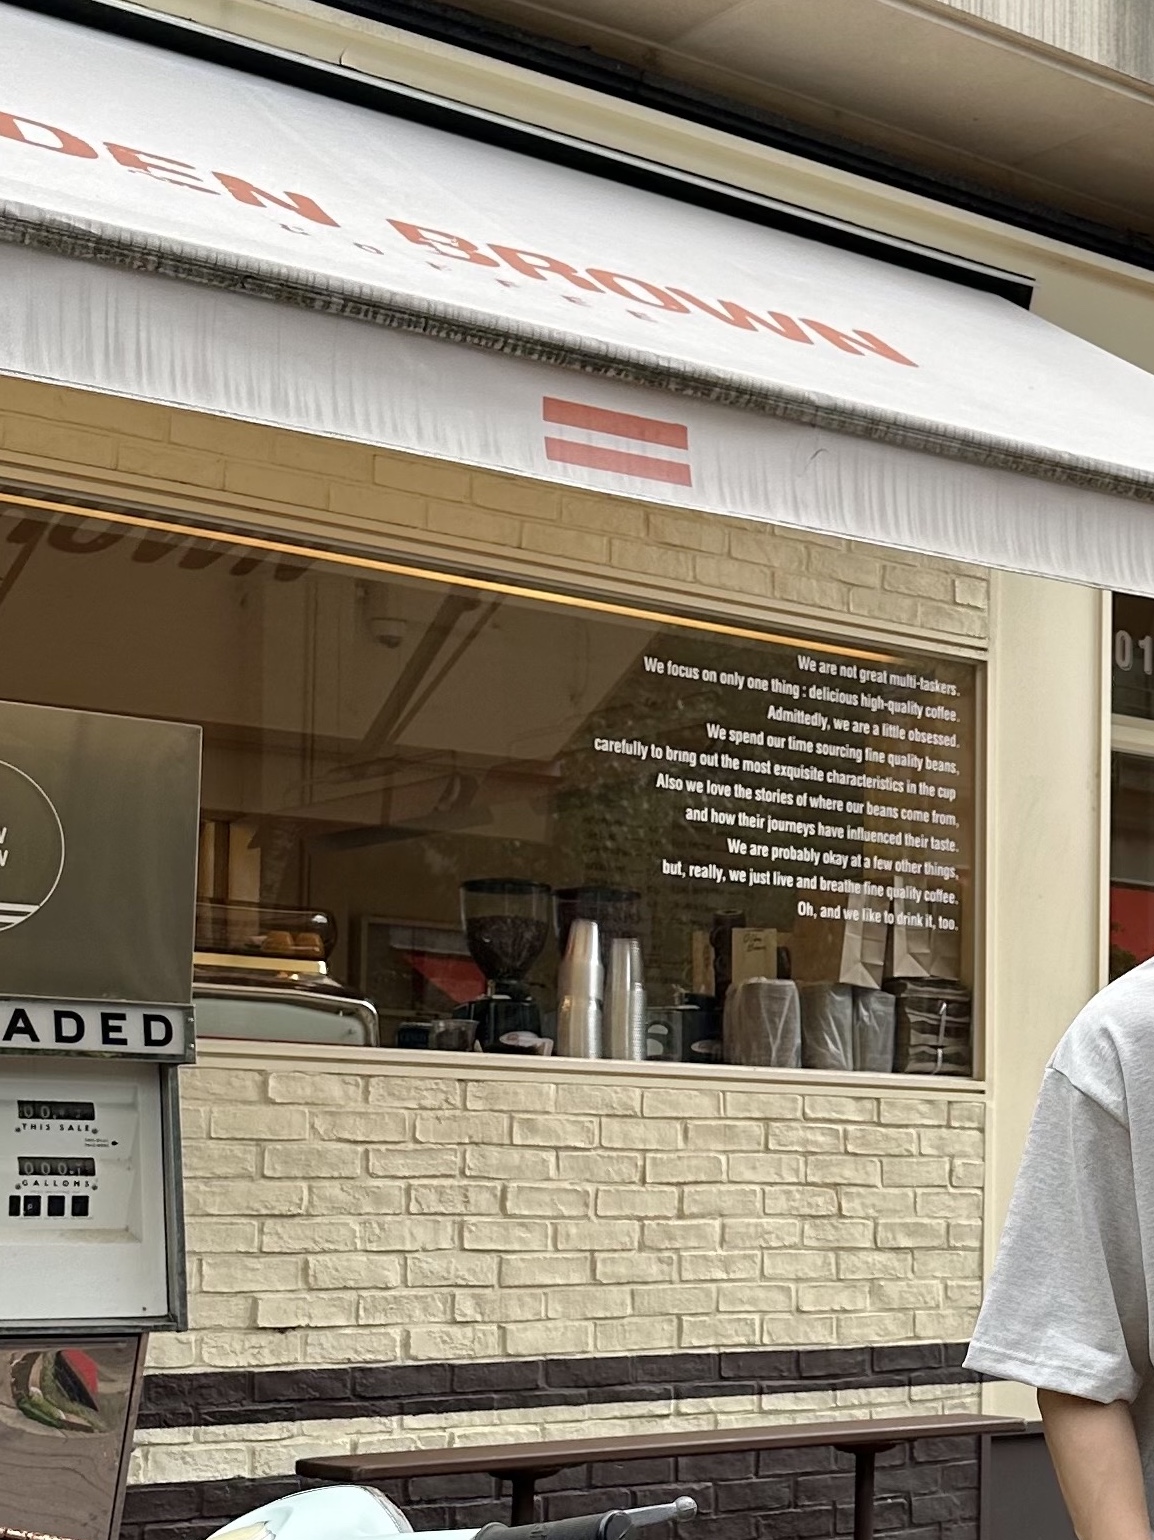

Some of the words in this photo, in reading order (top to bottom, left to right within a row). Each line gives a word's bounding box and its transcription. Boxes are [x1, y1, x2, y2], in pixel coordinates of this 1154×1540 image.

[386, 218, 918, 368] BROWN
[1114, 629, 1154, 675] 01
[643, 656, 665, 674] We
[667, 659, 700, 680] focus
[702, 669, 718, 683] on
[719, 671, 745, 691] only
[747, 676, 768, 692] one
[771, 678, 800, 700] thing
[809, 685, 859, 706] delicious
[860, 693, 924, 719] high-quality
[925, 705, 961, 722] coffee.
[797, 655, 817, 672] We
[818, 661, 837, 675] are
[839, 665, 858, 680] not
[859, 669, 888, 684] great
[889, 673, 961, 697] multi-taskers.
[706, 722, 727, 740] We
[728, 728, 764, 746] spend
[766, 735, 786, 749] our
[788, 736, 814, 754] time
[815, 741, 863, 763] sourcing
[864, 747, 886, 763] fine
[887, 750, 924, 772] quality
[925, 756, 960, 776] beans,
[767, 705, 831, 731] Admittedly,
[833, 718, 850, 731] we
[852, 721, 870, 735] are
[872, 724, 880, 736] a
[882, 722, 906, 741] little
[908, 727, 961, 749] obsessed.
[594, 737, 648, 760] carefully
[650, 743, 663, 760] to
[665, 745, 697, 768] bring
[699, 752, 720, 768] out
[720, 753, 740, 770] the
[742, 759, 771, 776] most
[773, 762, 825, 782] exquisite
[826, 769, 905, 793] characteristics
[906, 779, 917, 795] in
[918, 781, 935, 798] the
[937, 788, 956, 802] cup
[656, 772, 684, 791] Also
[685, 780, 704, 794] we
[706, 779, 731, 798] love
[733, 783, 752, 800] the
[754, 787, 794, 806] stories
[796, 792, 808, 807] of
[809, 794, 844, 812] where
[845, 800, 865, 815] our
[866, 800, 899, 819] beans
[900, 808, 930, 823] come
[931, 809, 960, 829] from,
[685, 807, 708, 823] and
[710, 808, 736, 826] how
[737, 811, 766, 829] their
[766, 815, 816, 838] journeys
[817, 822, 845, 839] have
[846, 824, 903, 846] influenced
[904, 832, 929, 848] their
[930, 836, 960, 853] taste.
[662, 859, 686, 878] but,
[688, 864, 726, 884] really,
[728, 869, 747, 882] we
[748, 868, 771, 887] just
[772, 871, 794, 888] live
[796, 875, 817, 890] and
[819, 875, 861, 895] breathe
[862, 880, 884, 897] fine
[886, 884, 923, 904] quality
[923, 888, 960, 905] coffee.
[727, 838, 748, 855] We
[749, 843, 769, 858] are
[771, 845, 821, 866] probably
[822, 850, 849, 869] okay
[850, 854, 862, 868] at
[863, 857, 871, 869] a
[872, 855, 893, 871] few
[894, 858, 923, 874] other
[923, 861, 960, 881] things,
[797, 900, 818, 920] Oh,
[819, 905, 841, 920] and
[843, 908, 860, 921] we
[861, 907, 882, 924] like
[883, 910, 895, 925] to
[896, 911, 924, 928] drink
[925, 913, 938, 930] it,
[938, 915, 960, 932] too.
[2, 1008, 173, 1047] ADED
[21, 1123, 51, 1131] THIS
[59, 1124, 90, 1132] SALE
[21, 1180, 90, 1188] GALLONS
